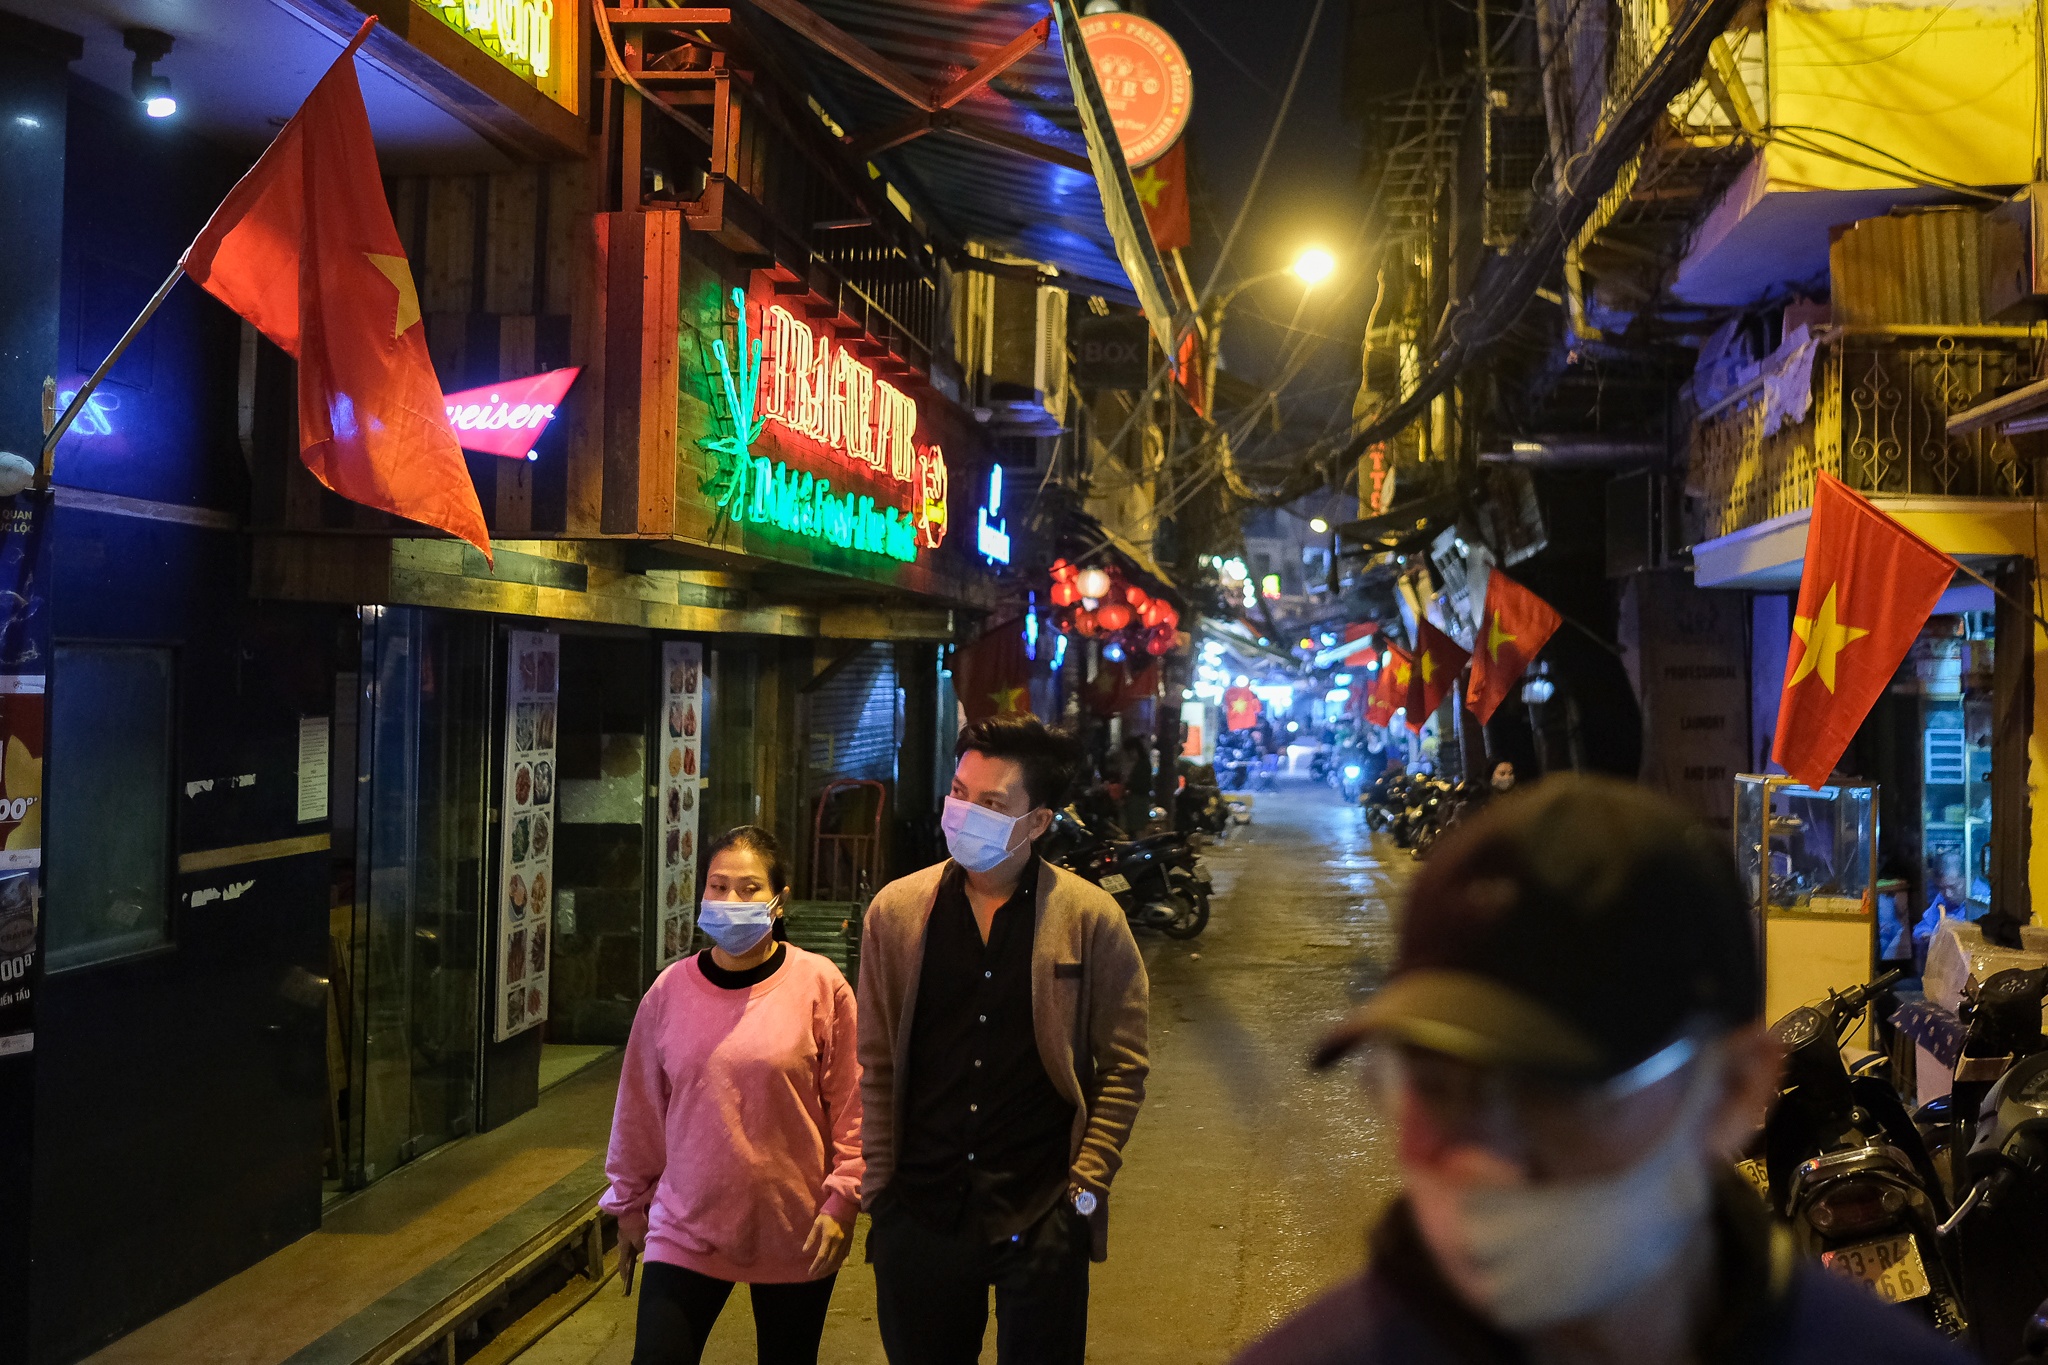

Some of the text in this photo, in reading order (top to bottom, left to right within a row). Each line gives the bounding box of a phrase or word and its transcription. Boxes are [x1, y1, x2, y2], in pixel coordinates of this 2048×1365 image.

[1125, 23, 1167, 55] PASTA
[1169, 64, 1185, 104] PIZZA
[1085, 341, 1139, 362] BOX
[1663, 665, 1737, 680] PROFESSIONAL
[1679, 715, 1725, 731] LAUNDRY
[1706, 765, 1726, 780] DRY
